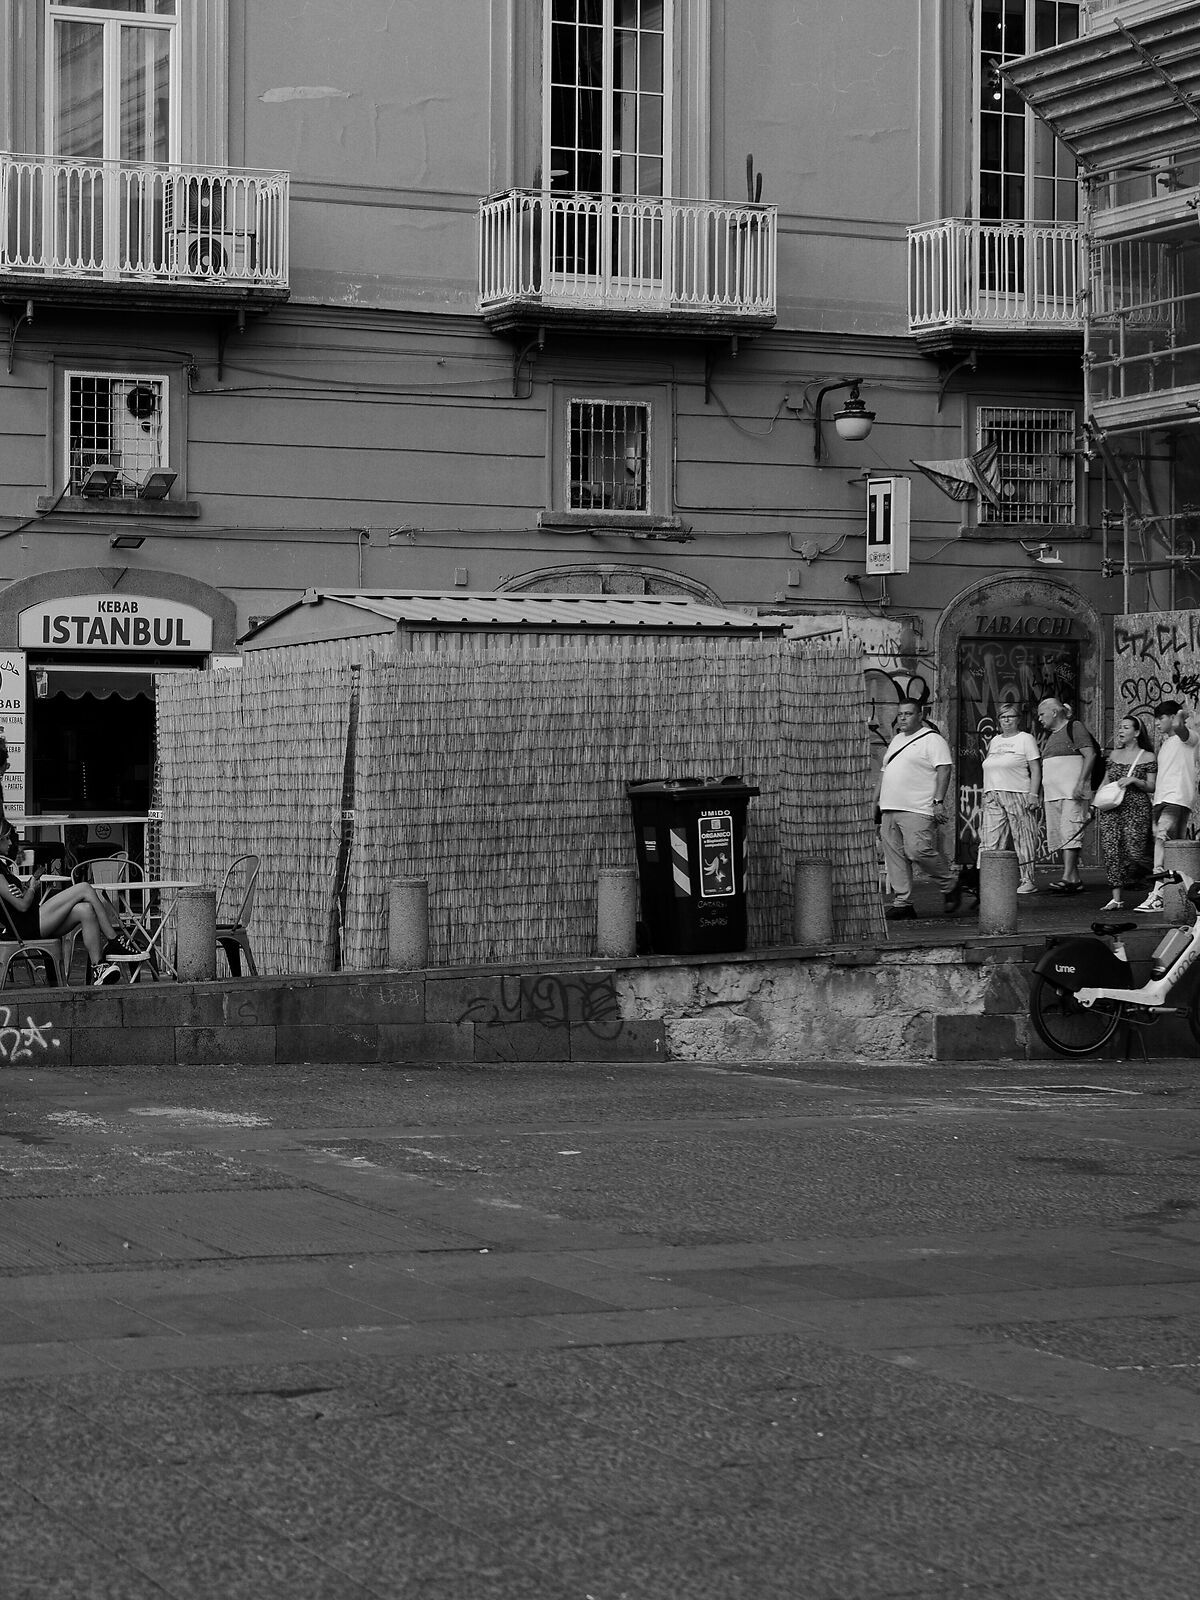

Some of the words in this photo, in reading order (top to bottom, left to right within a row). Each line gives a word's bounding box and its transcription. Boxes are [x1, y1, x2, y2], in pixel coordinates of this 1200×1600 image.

[98, 601, 138, 613] KEBAB
[42, 615, 191, 646] ISTANBUL
[975, 615, 1074, 635] TABACCHI
